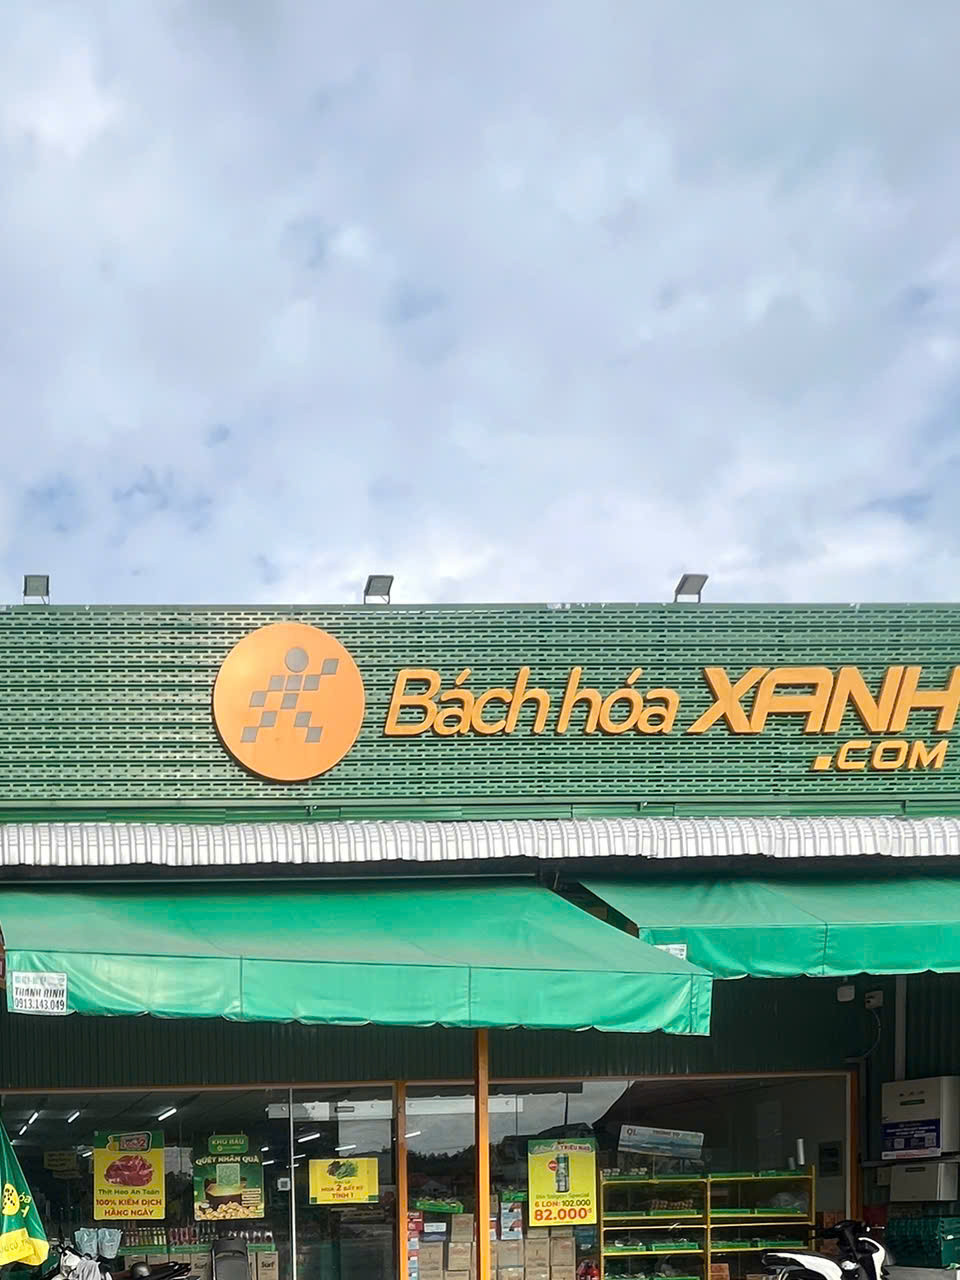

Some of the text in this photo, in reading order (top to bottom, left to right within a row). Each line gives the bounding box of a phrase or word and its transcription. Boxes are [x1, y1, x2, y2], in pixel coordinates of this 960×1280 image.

[385, 665, 960, 735] Bách hóa XANH
[812, 740, 948, 771] .COM
[562, 1199, 591, 1207] 102.000
